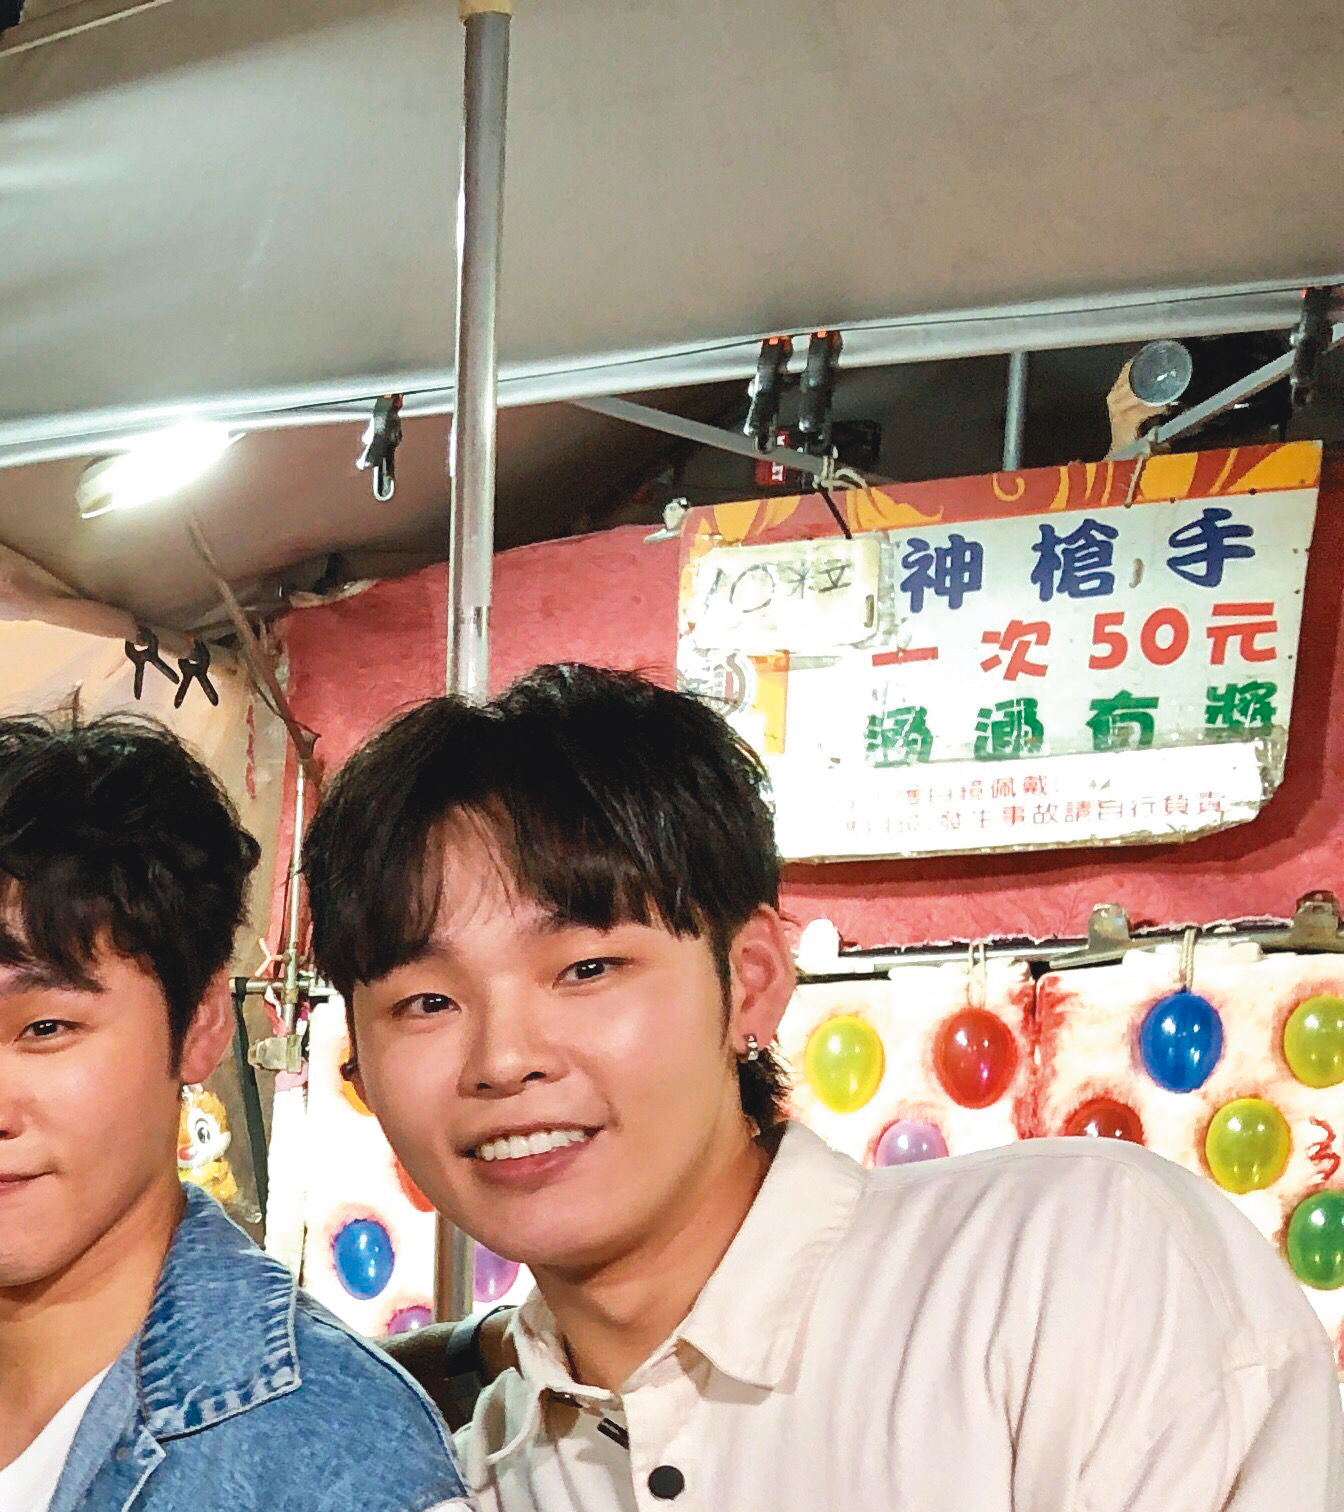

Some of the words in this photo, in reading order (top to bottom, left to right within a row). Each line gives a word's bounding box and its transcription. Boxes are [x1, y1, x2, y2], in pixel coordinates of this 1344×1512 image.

[899, 507, 1256, 613] 神槍手
[871, 602, 1279, 681] 一次50元
